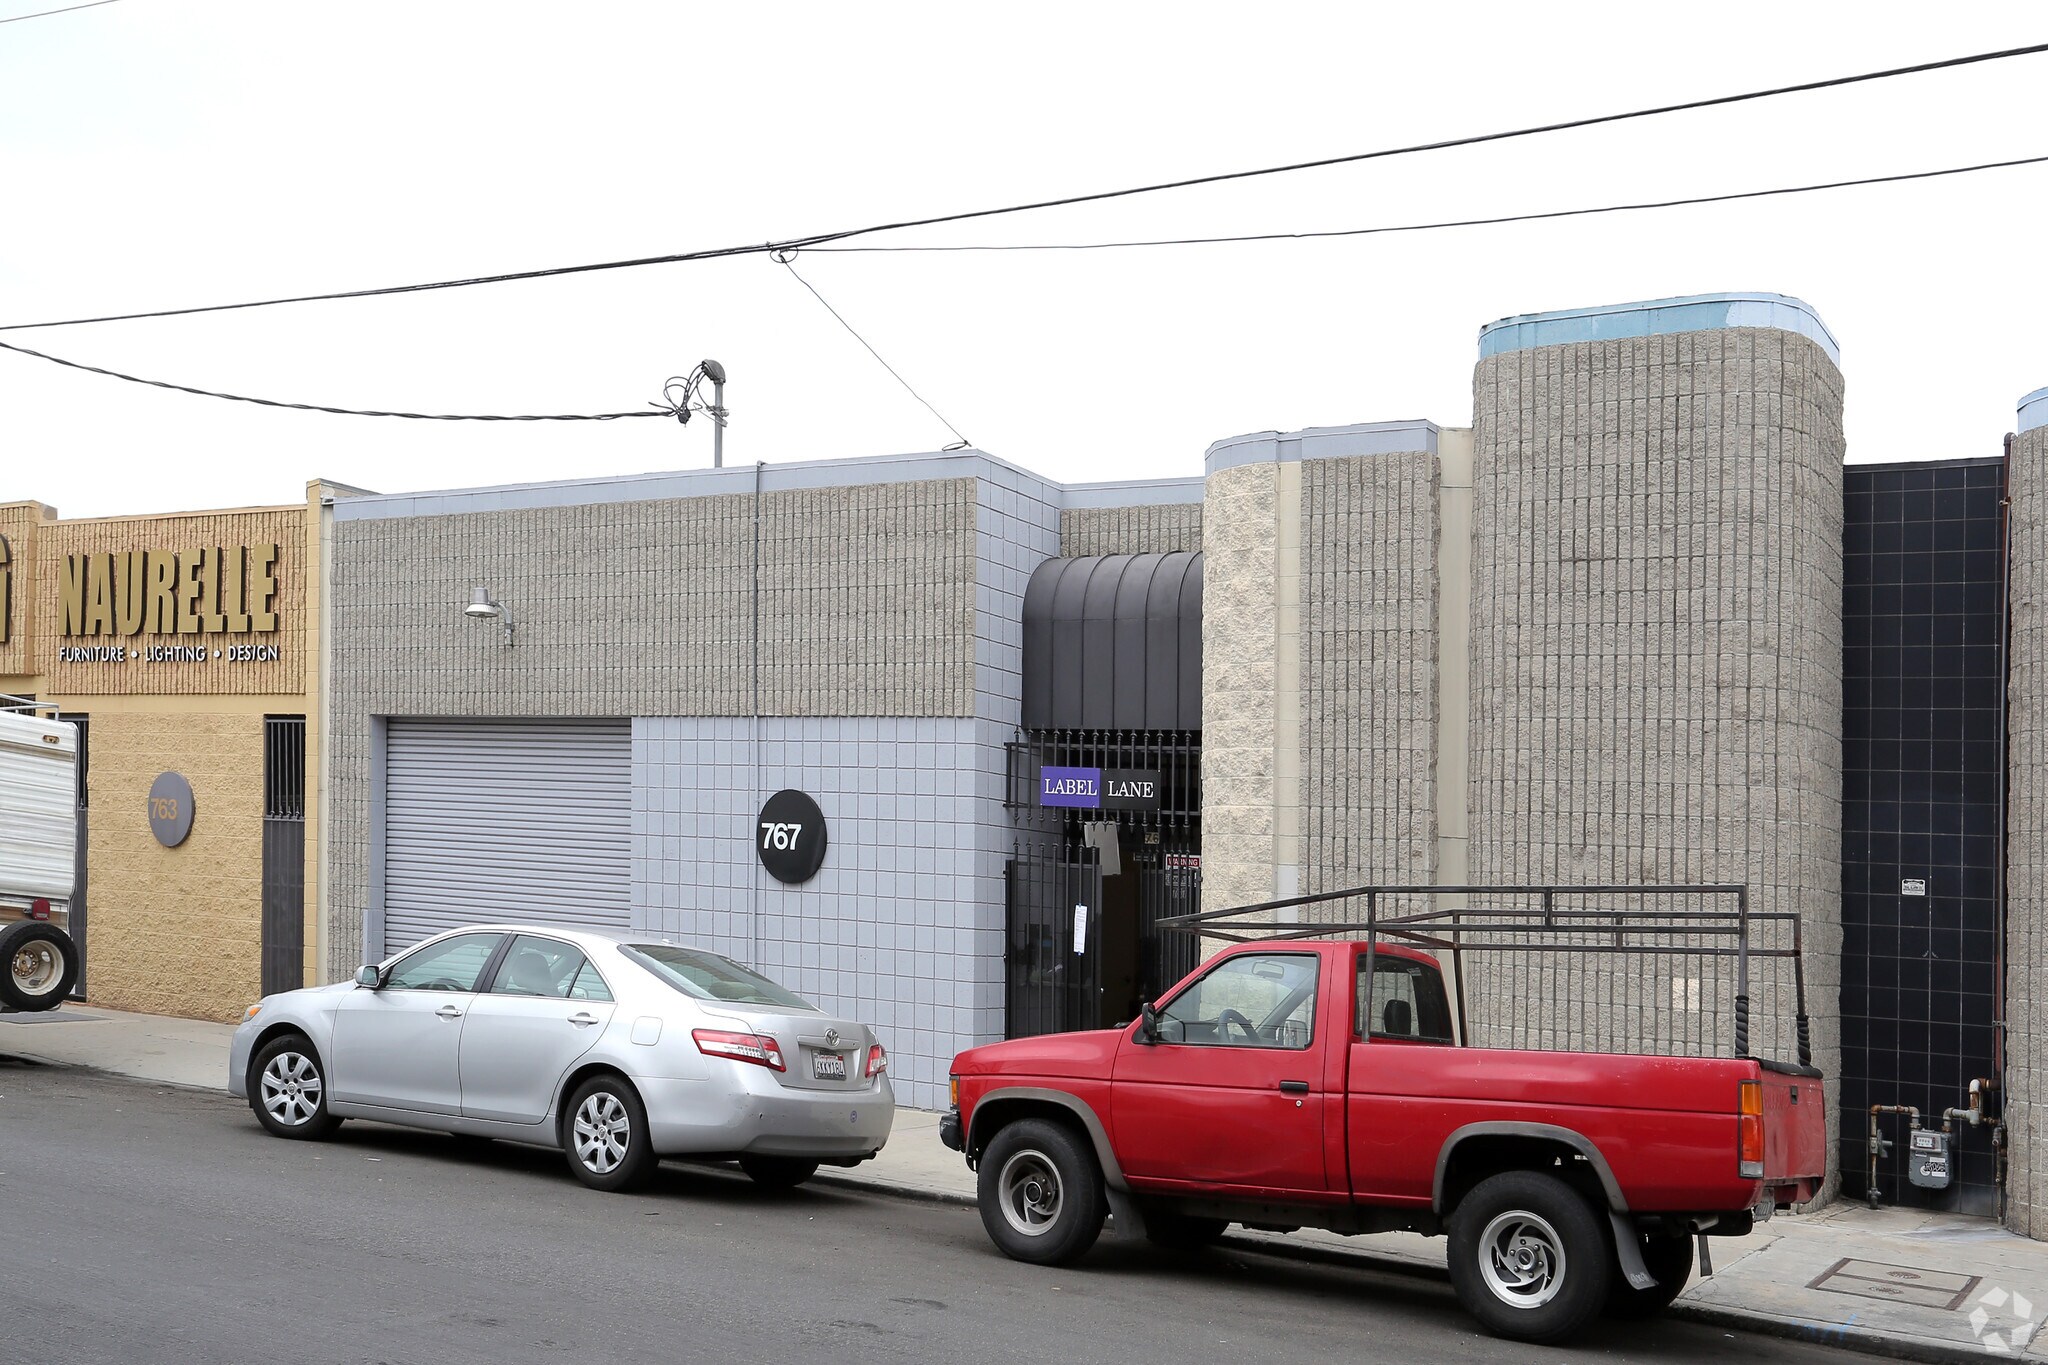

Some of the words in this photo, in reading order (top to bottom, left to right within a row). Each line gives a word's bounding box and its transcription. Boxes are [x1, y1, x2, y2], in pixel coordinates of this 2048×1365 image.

[58, 544, 278, 636] NAURELLE
[59, 646, 125, 662] FURNITURE
[145, 645, 207, 662] LIGHTING
[228, 645, 279, 662] DESIGN
[1044, 778, 1098, 796] LABEL
[1107, 780, 1154, 798] LANE
[150, 797, 178, 820] 763
[761, 822, 802, 851] 767
